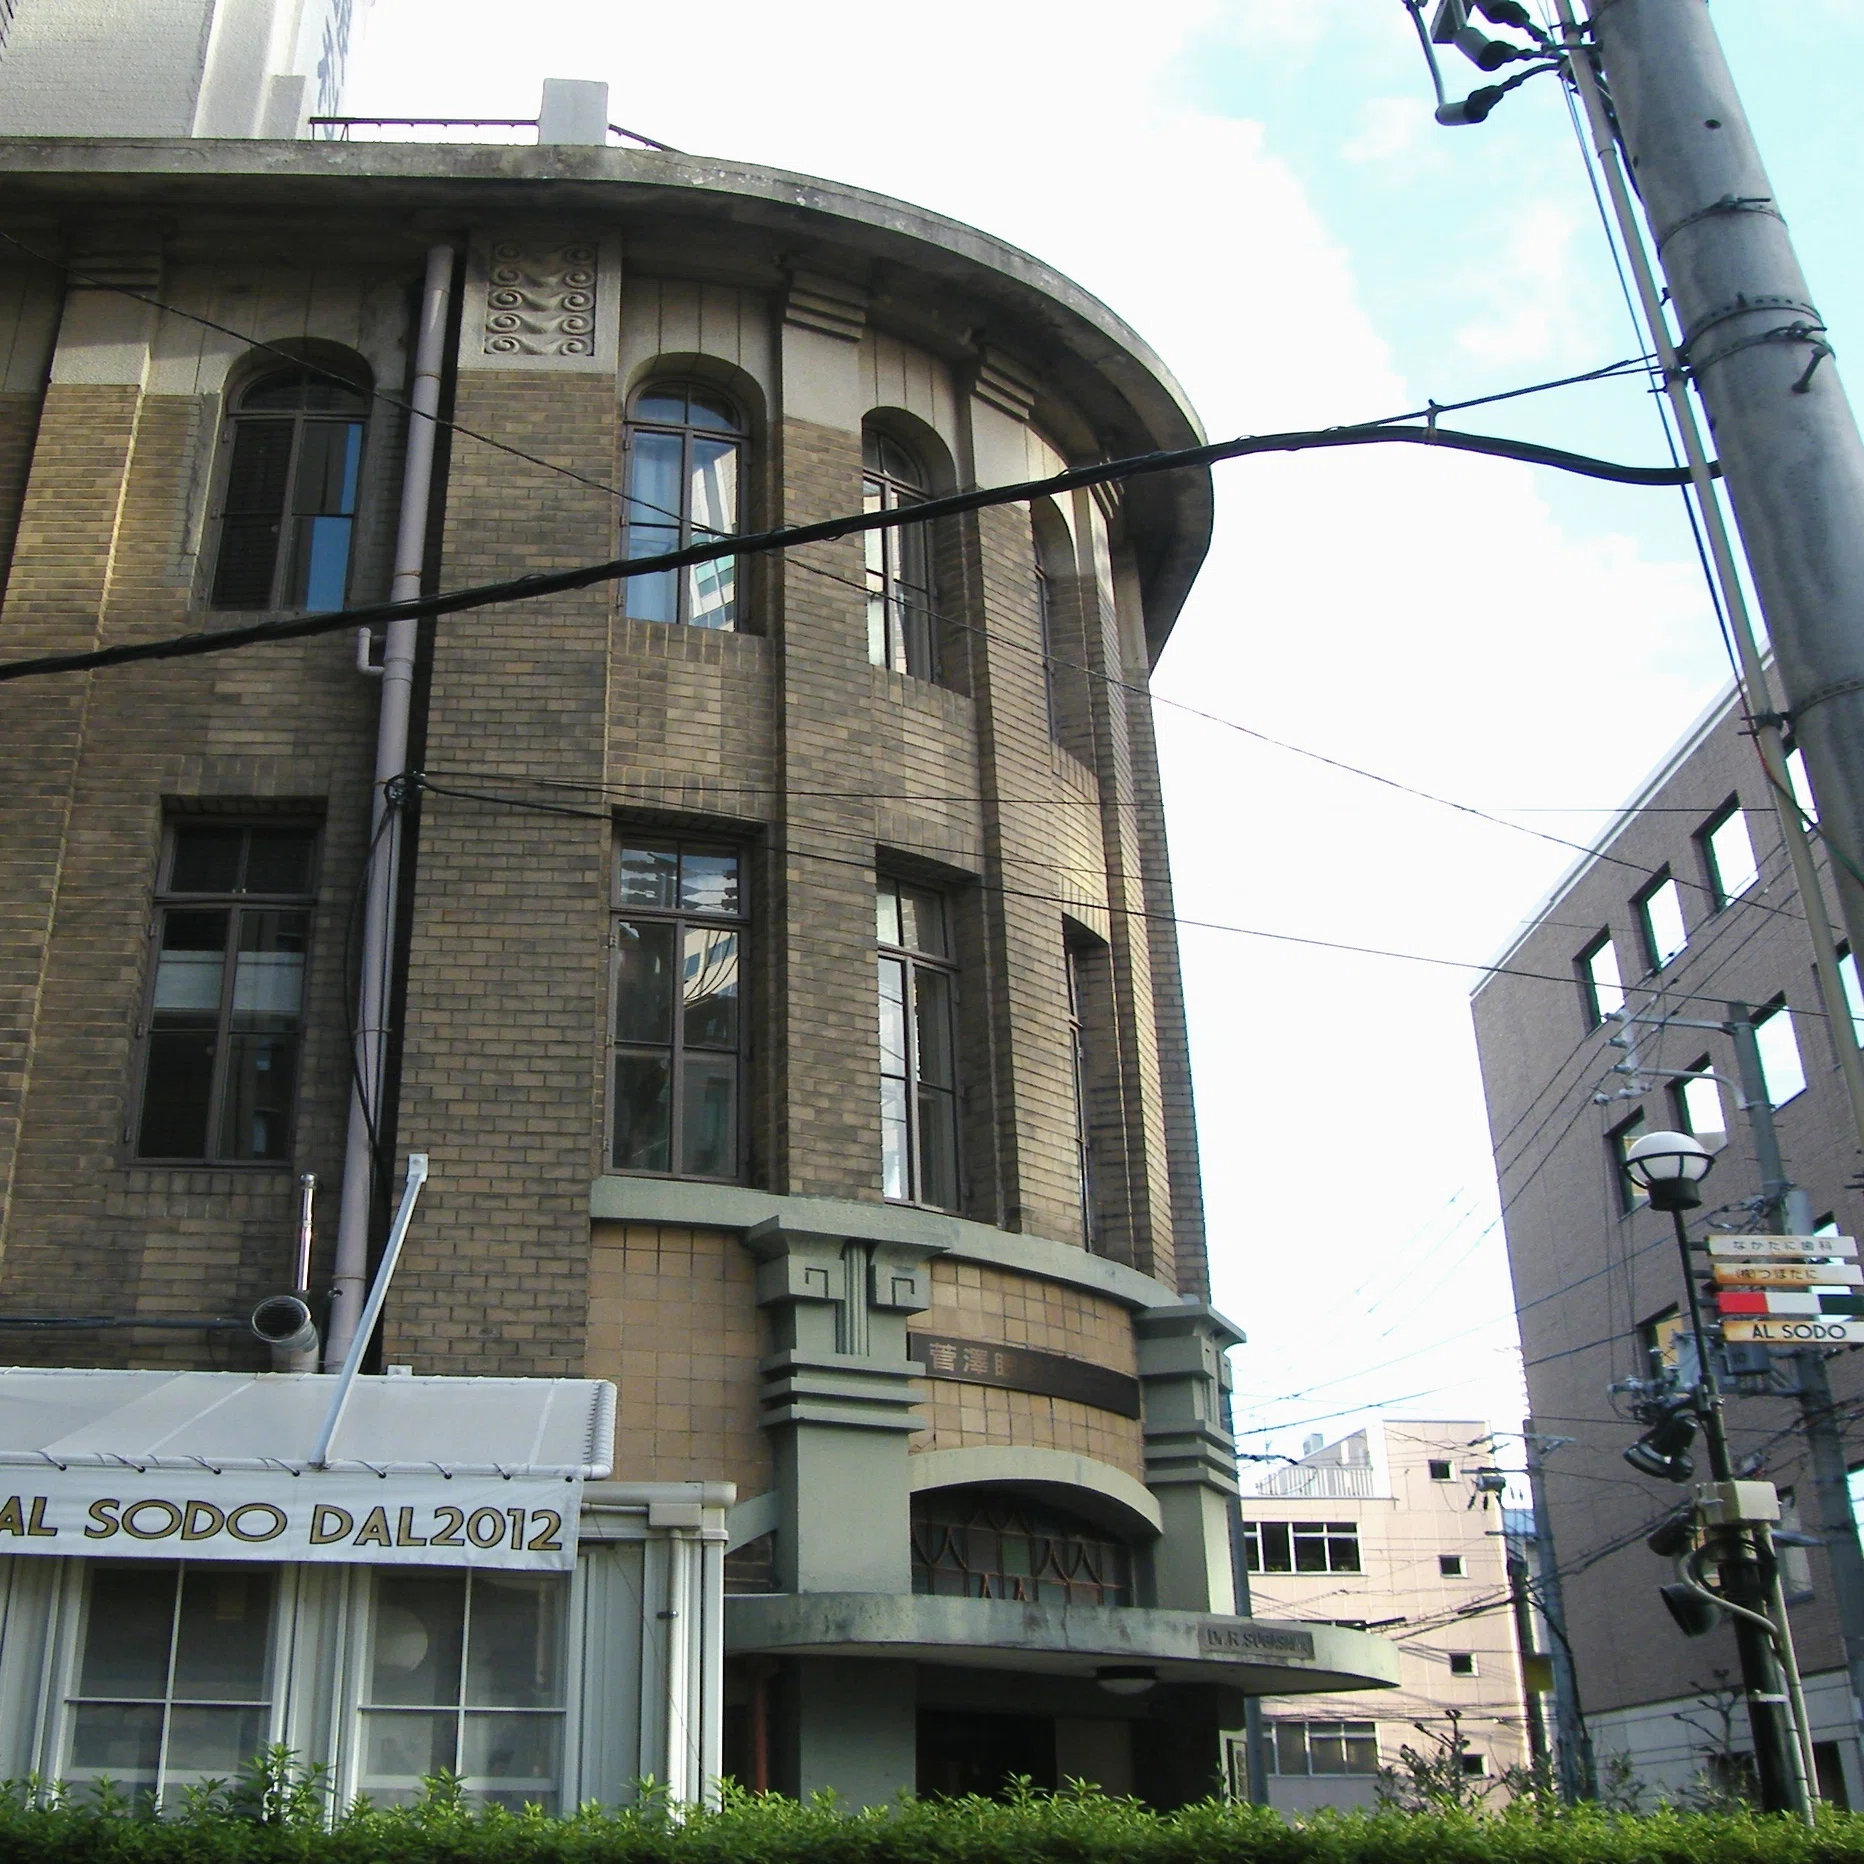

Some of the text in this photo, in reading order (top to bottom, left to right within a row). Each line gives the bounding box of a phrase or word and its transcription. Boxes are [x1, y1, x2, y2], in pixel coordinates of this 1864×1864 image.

[1752, 1324, 1847, 1339] AL SODO
[0, 1496, 562, 1551] AL SODO DAL2012
